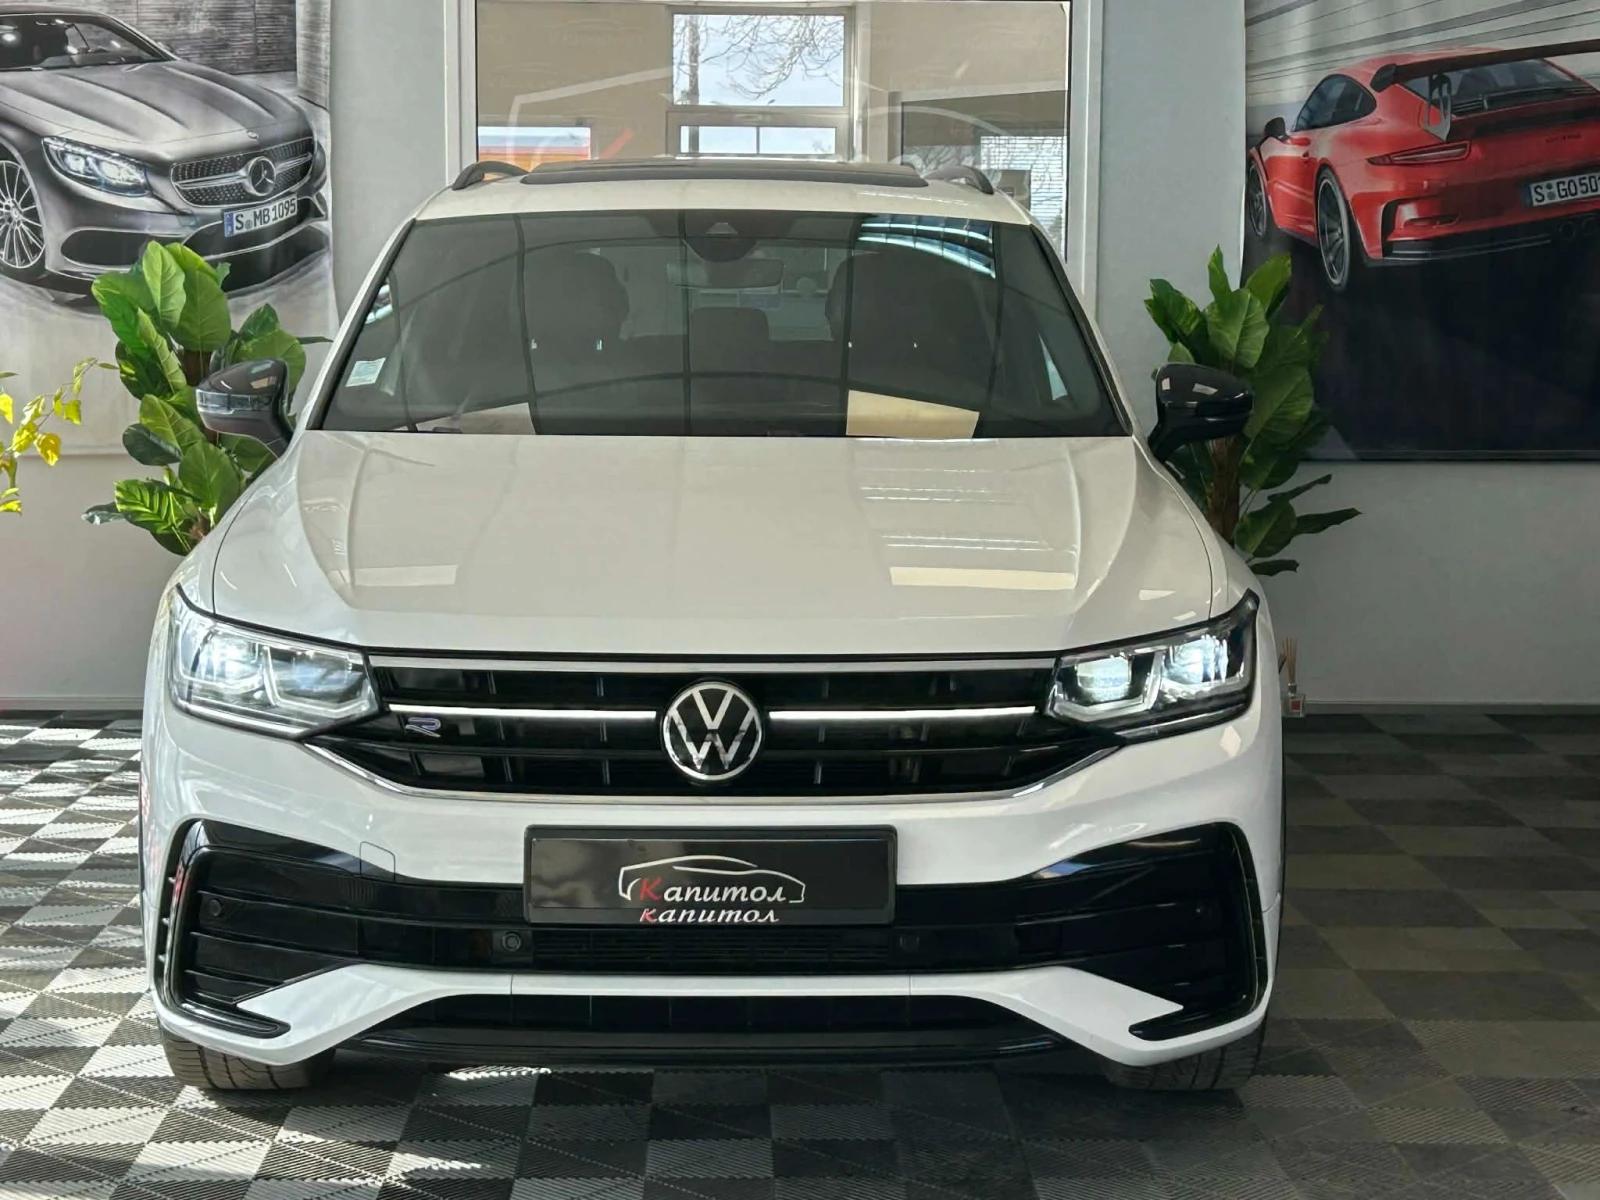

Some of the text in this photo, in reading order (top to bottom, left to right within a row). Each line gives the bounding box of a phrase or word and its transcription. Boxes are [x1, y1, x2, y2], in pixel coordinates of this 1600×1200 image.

[1534, 185, 1545, 203] S
[235, 214, 244, 230] S
[639, 877, 787, 902] Капитол
